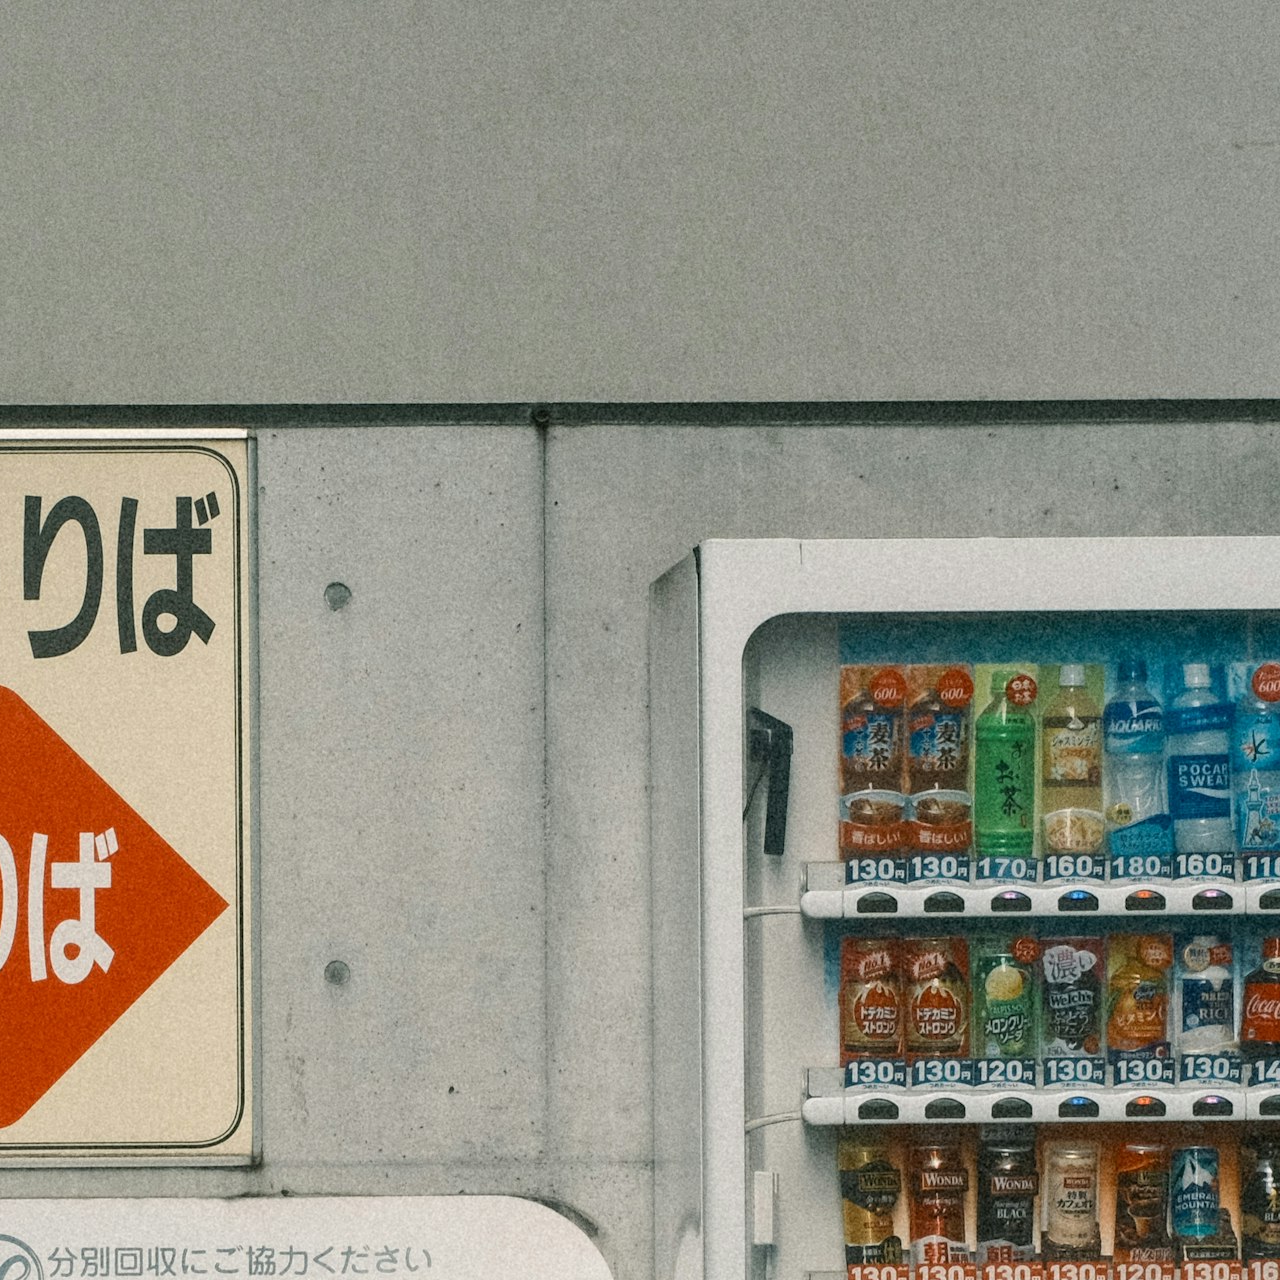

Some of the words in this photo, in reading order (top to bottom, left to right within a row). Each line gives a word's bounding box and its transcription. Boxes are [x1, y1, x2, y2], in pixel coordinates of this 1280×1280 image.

[869, 721, 890, 771] 麦茶
[936, 721, 958, 771] 麦茶
[849, 858, 905, 879] 130円
[912, 857, 967, 877] 130円
[979, 859, 1035, 879] 170円
[1047, 856, 1102, 877] 160円
[1113, 857, 1170, 876] 180円
[1177, 854, 1232, 874] 160円
[848, 1062, 904, 1083] 130円
[915, 1061, 971, 1081] 130円
[977, 1061, 1033, 1081] 120円
[1046, 1061, 1103, 1081] 130円
[1117, 1060, 1172, 1080] 130円
[1184, 1057, 1239, 1078] 130円
[924, 1172, 964, 1187] WONDA
[993, 1176, 1034, 1191] WONDA
[47, 1246, 433, 1277] 分別回収にご協力ください
